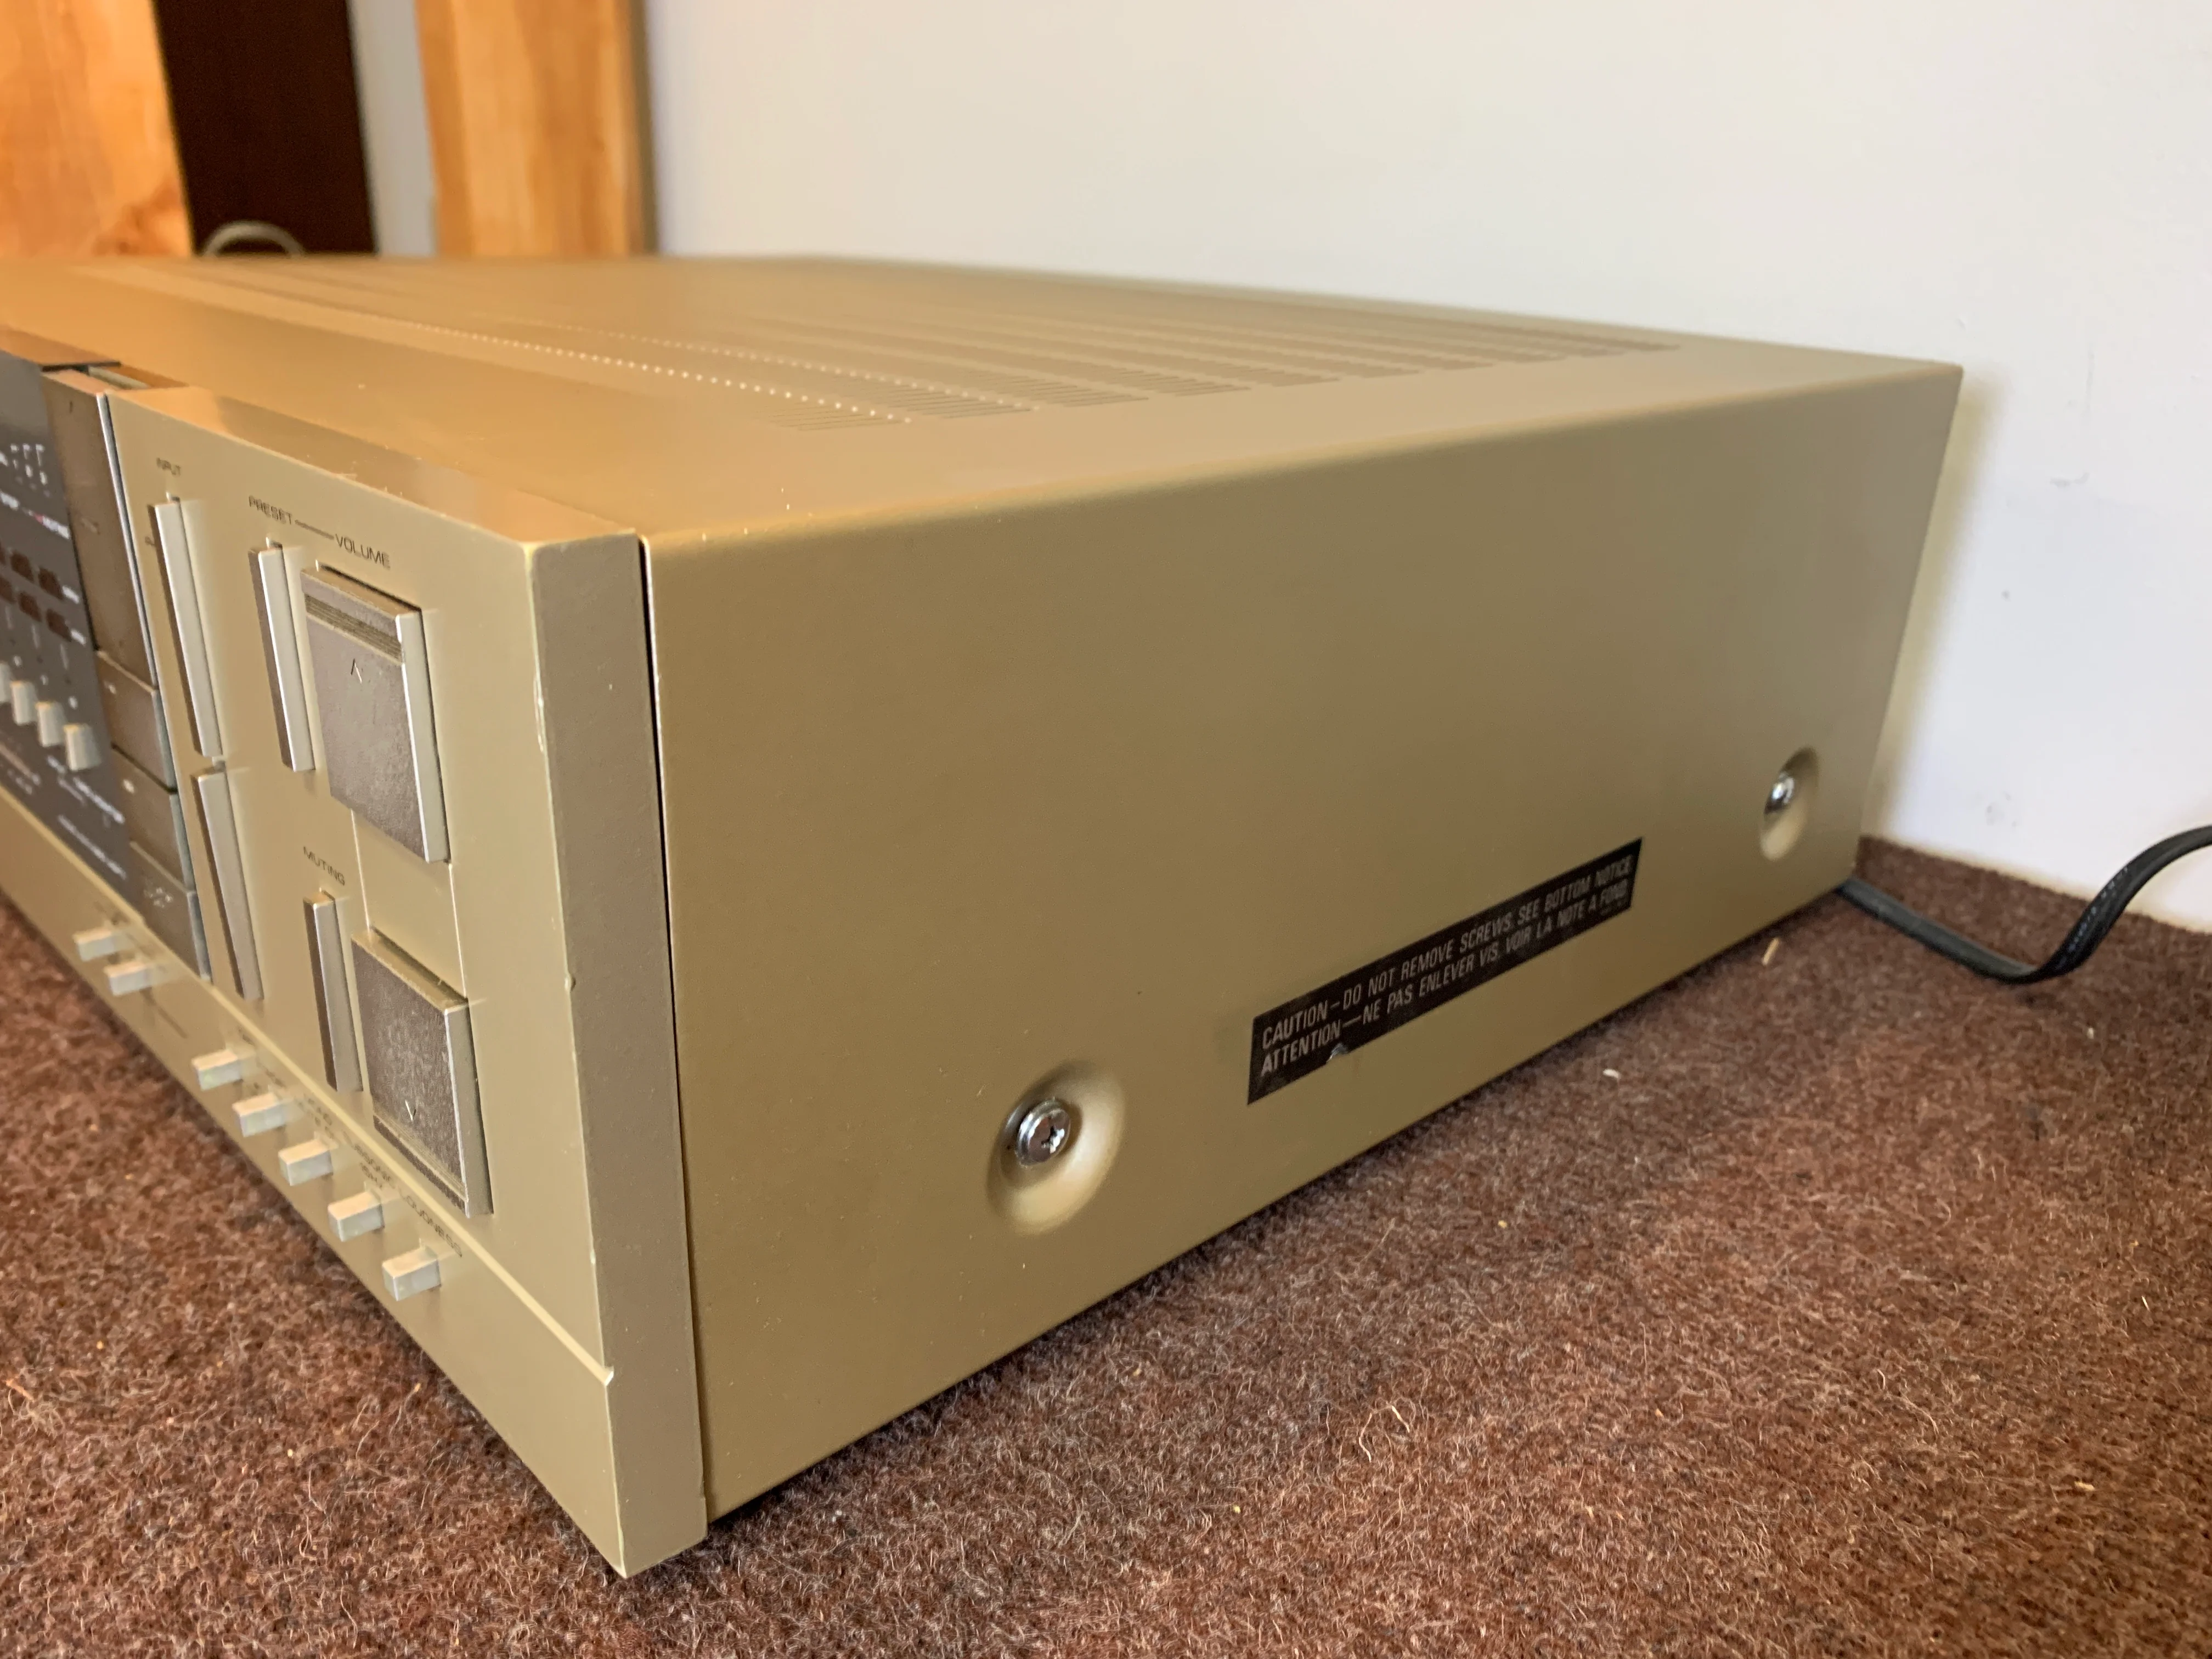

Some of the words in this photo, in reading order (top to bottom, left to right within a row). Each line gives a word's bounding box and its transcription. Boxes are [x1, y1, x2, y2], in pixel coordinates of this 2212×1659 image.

[249, 495, 292, 525] PRESET
[335, 533, 391, 570] VOLUME
[303, 846, 345, 886] MUTING
[1368, 967, 1396, 998] NOT
[1401, 938, 1454, 981] REMOVE
[1517, 898, 1541, 926] SEE
[1544, 874, 1592, 913] BOTTOM
[1387, 984, 1414, 1014] PAS
[1419, 953, 1475, 997] ENLEVER
[1537, 915, 1553, 938] LA
